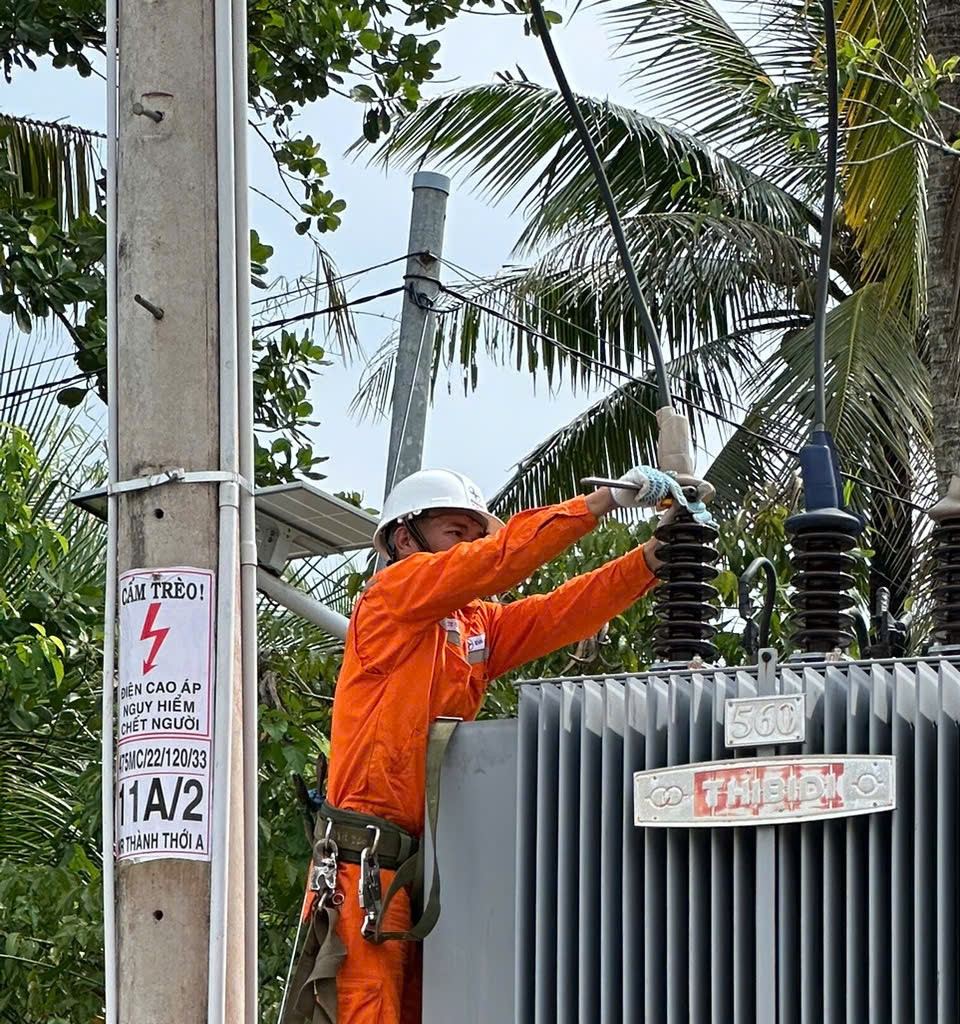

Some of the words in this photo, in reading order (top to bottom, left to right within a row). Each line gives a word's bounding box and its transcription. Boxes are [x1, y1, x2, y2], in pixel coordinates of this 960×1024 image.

[121, 682, 142, 700] ĐIỆN
[146, 681, 177, 694] CAO
[181, 678, 202, 694] ÁP
[123, 700, 153, 717] NGUY
[157, 693, 195, 713] HIỂM
[121, 714, 148, 735] CHẾT
[151, 714, 200, 731] NGƯỜI
[731, 702, 797, 739] 560
[702, 773, 836, 808] THIBIDI
[126, 829, 159, 852] THÀNH
[162, 828, 192, 849] THỚI
[195, 834, 204, 850] A
